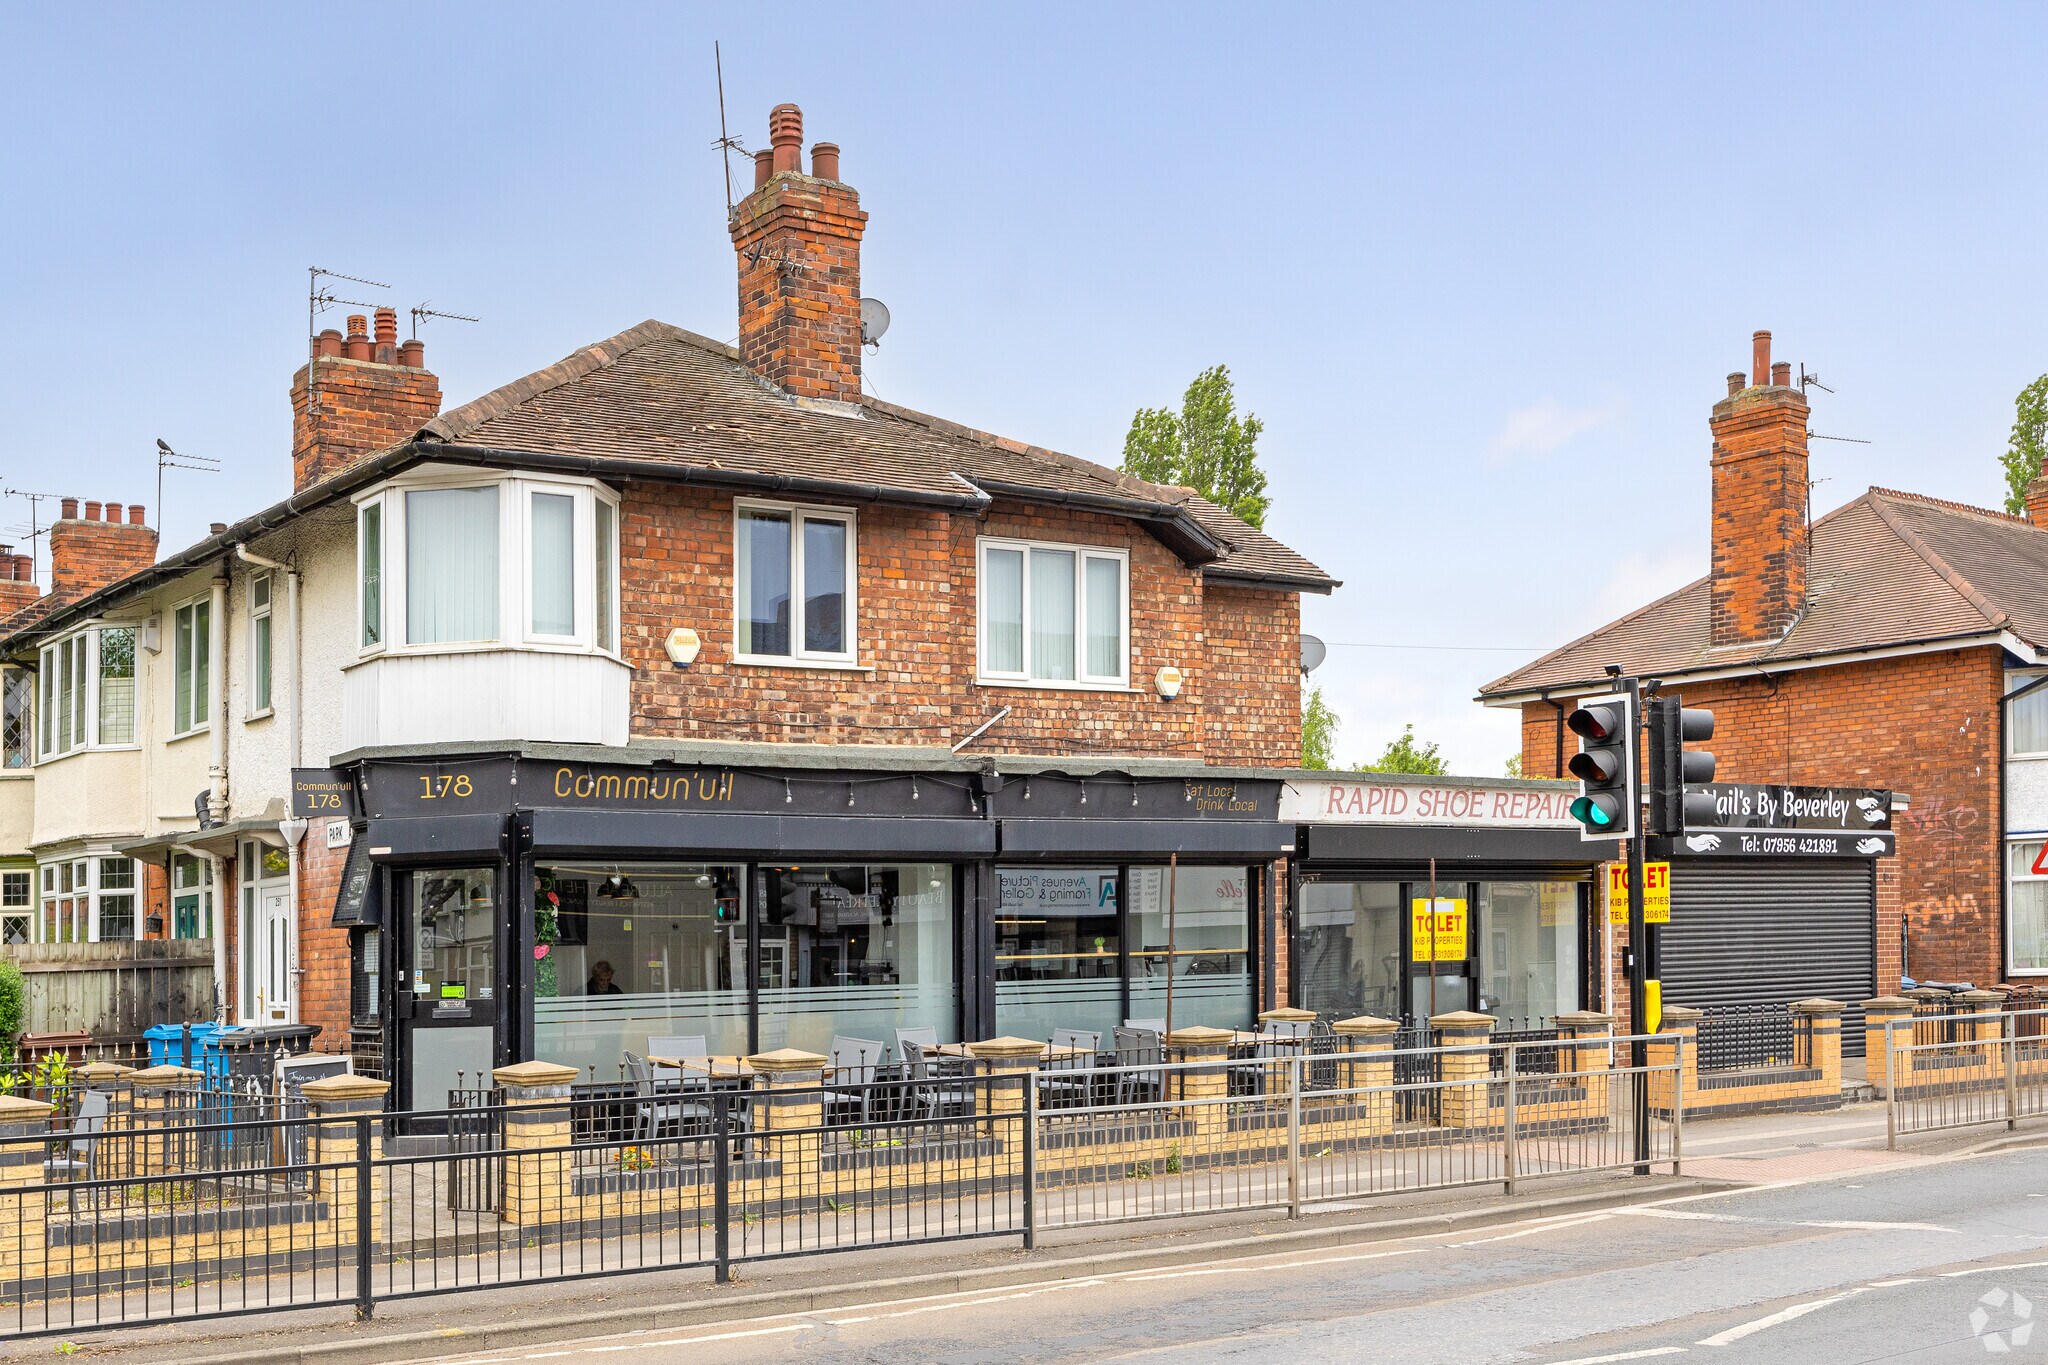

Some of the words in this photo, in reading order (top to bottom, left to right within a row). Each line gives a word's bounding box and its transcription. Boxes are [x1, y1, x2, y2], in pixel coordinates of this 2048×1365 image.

[296, 781, 352, 791] Commun'ull
[419, 774, 474, 799] 178
[554, 767, 734, 801] Commun'ull
[307, 794, 342, 809] 178
[1196, 798, 1224, 811] Drink
[1228, 799, 1258, 811] Local
[1327, 786, 1408, 815] RAPID
[1416, 788, 1486, 818] SHOE
[1757, 791, 1778, 825] By
[1783, 790, 1850, 827] Beverley
[328, 826, 344, 843] PARK
[1740, 836, 1759, 853] Tel:
[1763, 837, 1796, 853] 07956
[1799, 838, 1838, 853] 421891
[1610, 898, 1622, 906] KIB
[1624, 897, 1669, 906] PERTIES
[1437, 915, 1462, 932] LET
[1610, 911, 1623, 920] TEL
[1414, 936, 1424, 945] KIB
[1427, 935, 1463, 945] POPERTIES
[1415, 951, 1425, 959] TEL
